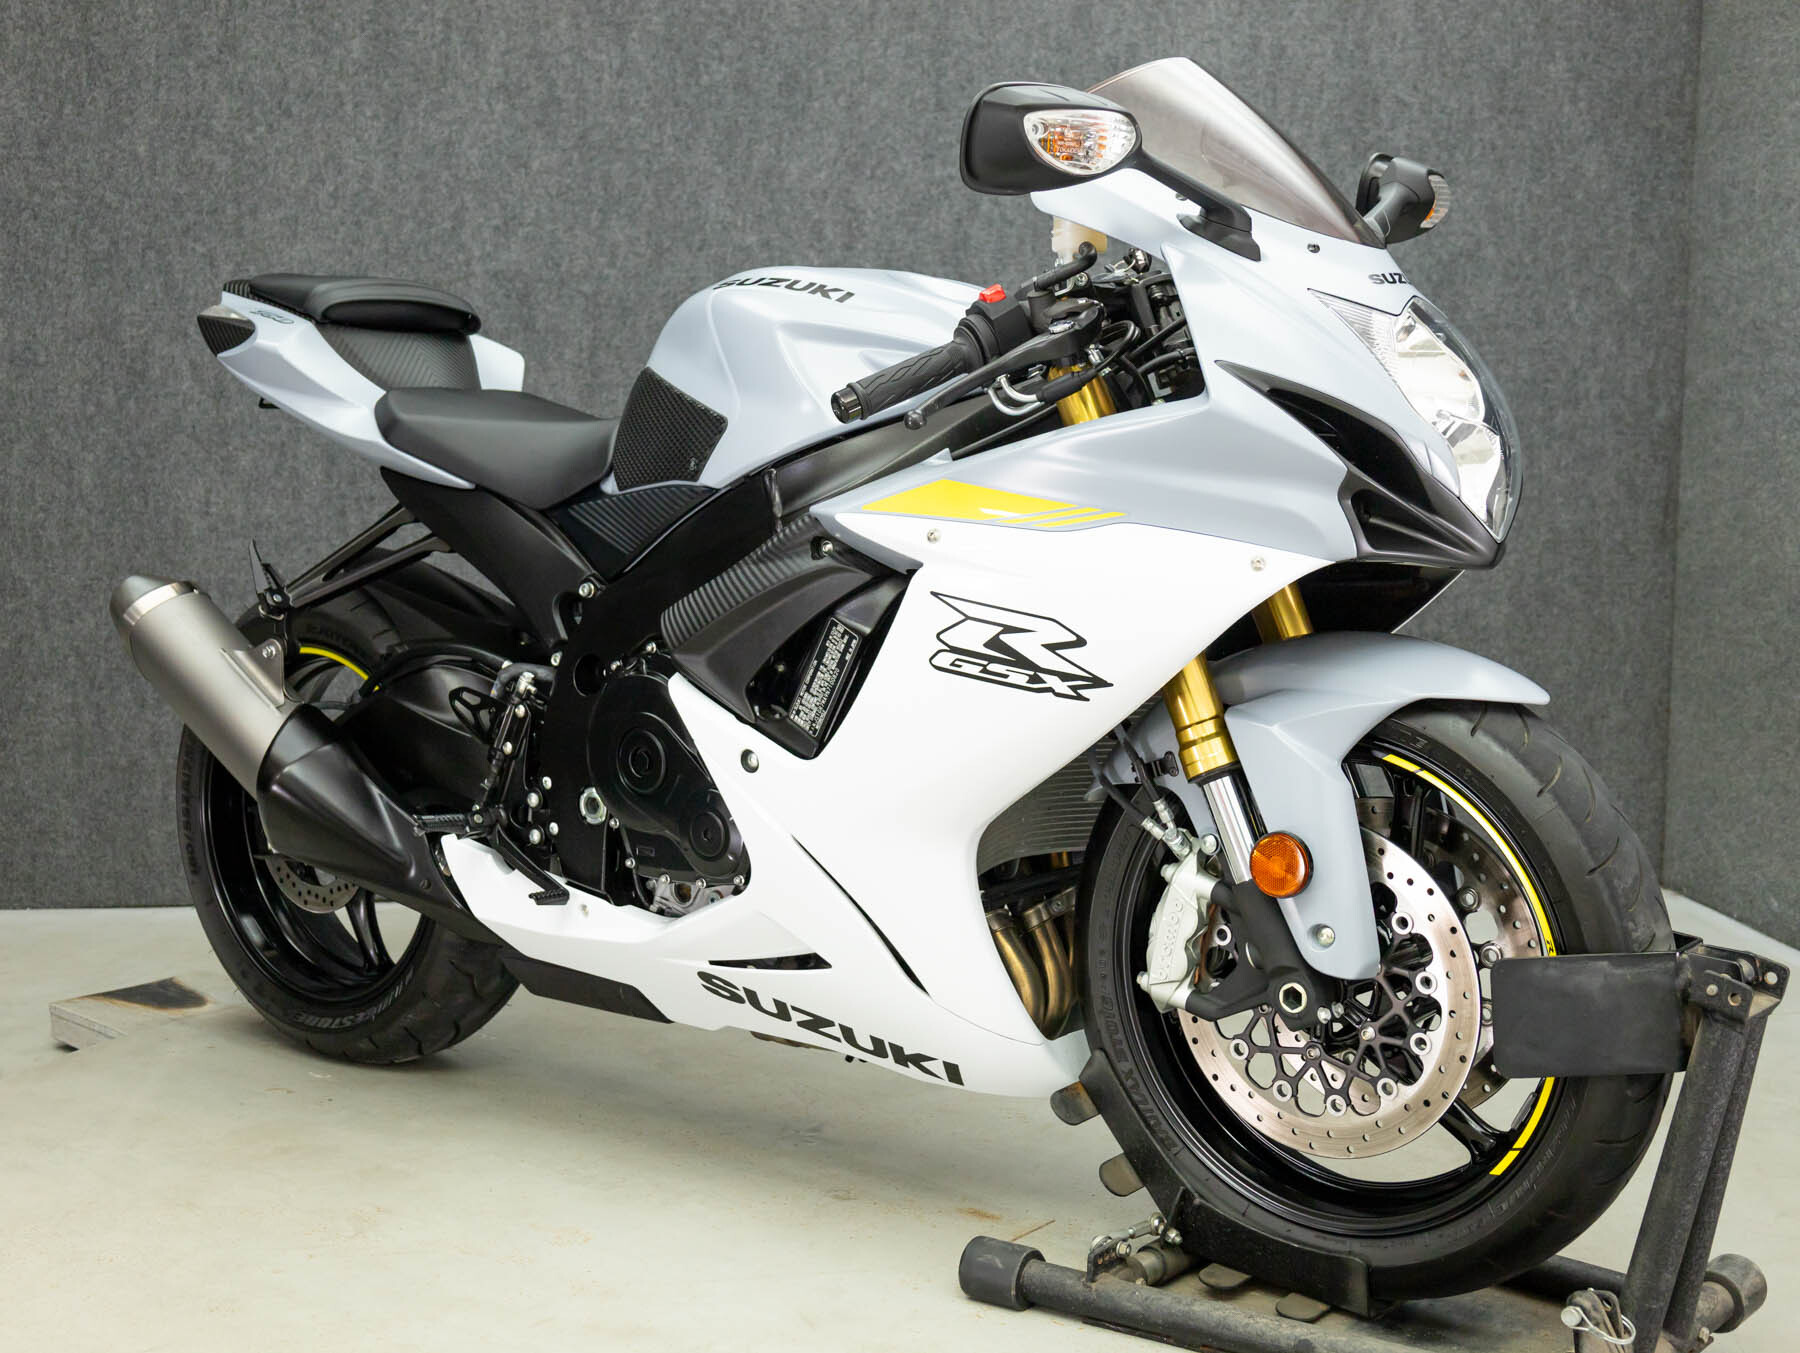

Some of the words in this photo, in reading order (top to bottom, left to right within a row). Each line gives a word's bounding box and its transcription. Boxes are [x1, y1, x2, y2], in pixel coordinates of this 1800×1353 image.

[713, 277, 855, 304] SUZUKI
[1368, 272, 1407, 285] SUZ
[697, 970, 965, 1086] SUZUKI
